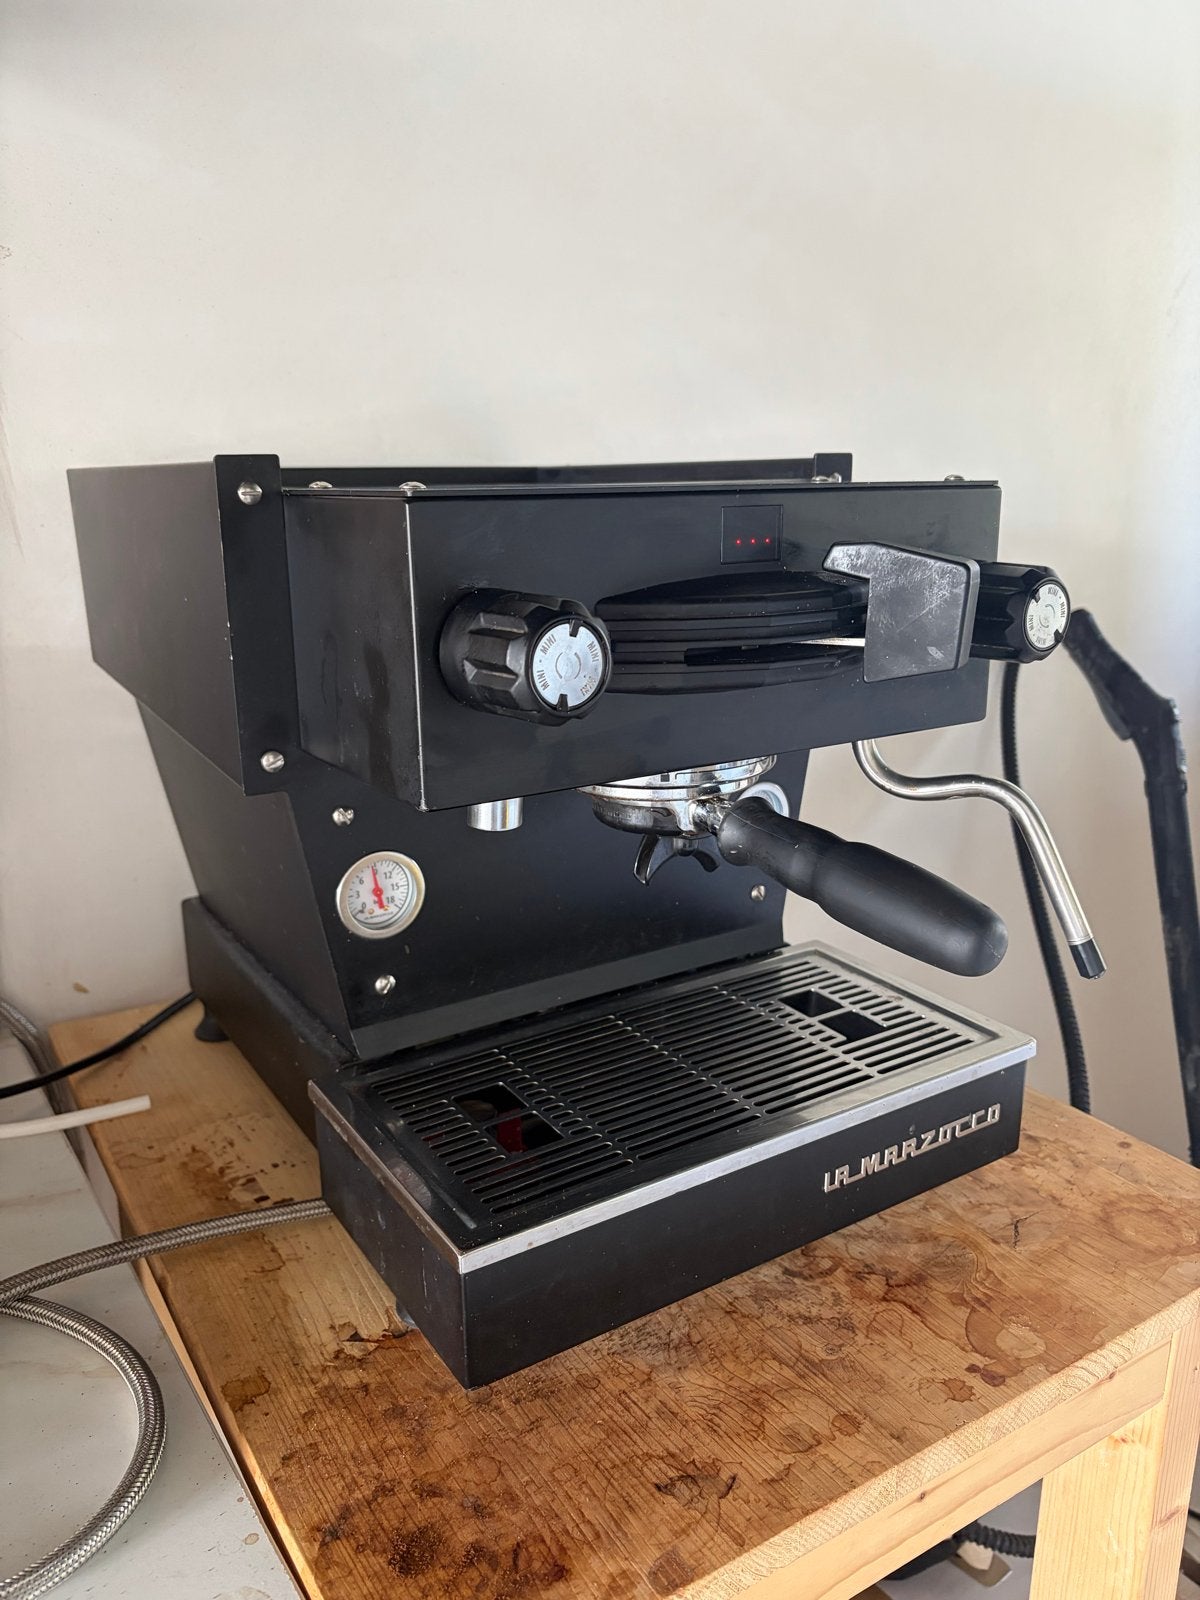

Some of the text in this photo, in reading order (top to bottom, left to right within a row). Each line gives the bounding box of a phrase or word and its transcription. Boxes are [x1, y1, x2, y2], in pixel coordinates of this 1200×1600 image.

[540, 633, 557, 655] MINI
[587, 640, 599, 663] MINI
[536, 669, 550, 691] MINI
[384, 870, 393, 880] 12
[359, 877, 365, 886] 6
[390, 883, 400, 892] 15
[355, 890, 361, 900] 3
[386, 895, 396, 904] 18
[361, 901, 367, 911] 0
[824, 1102, 1001, 1193] LA MARZOCCO
